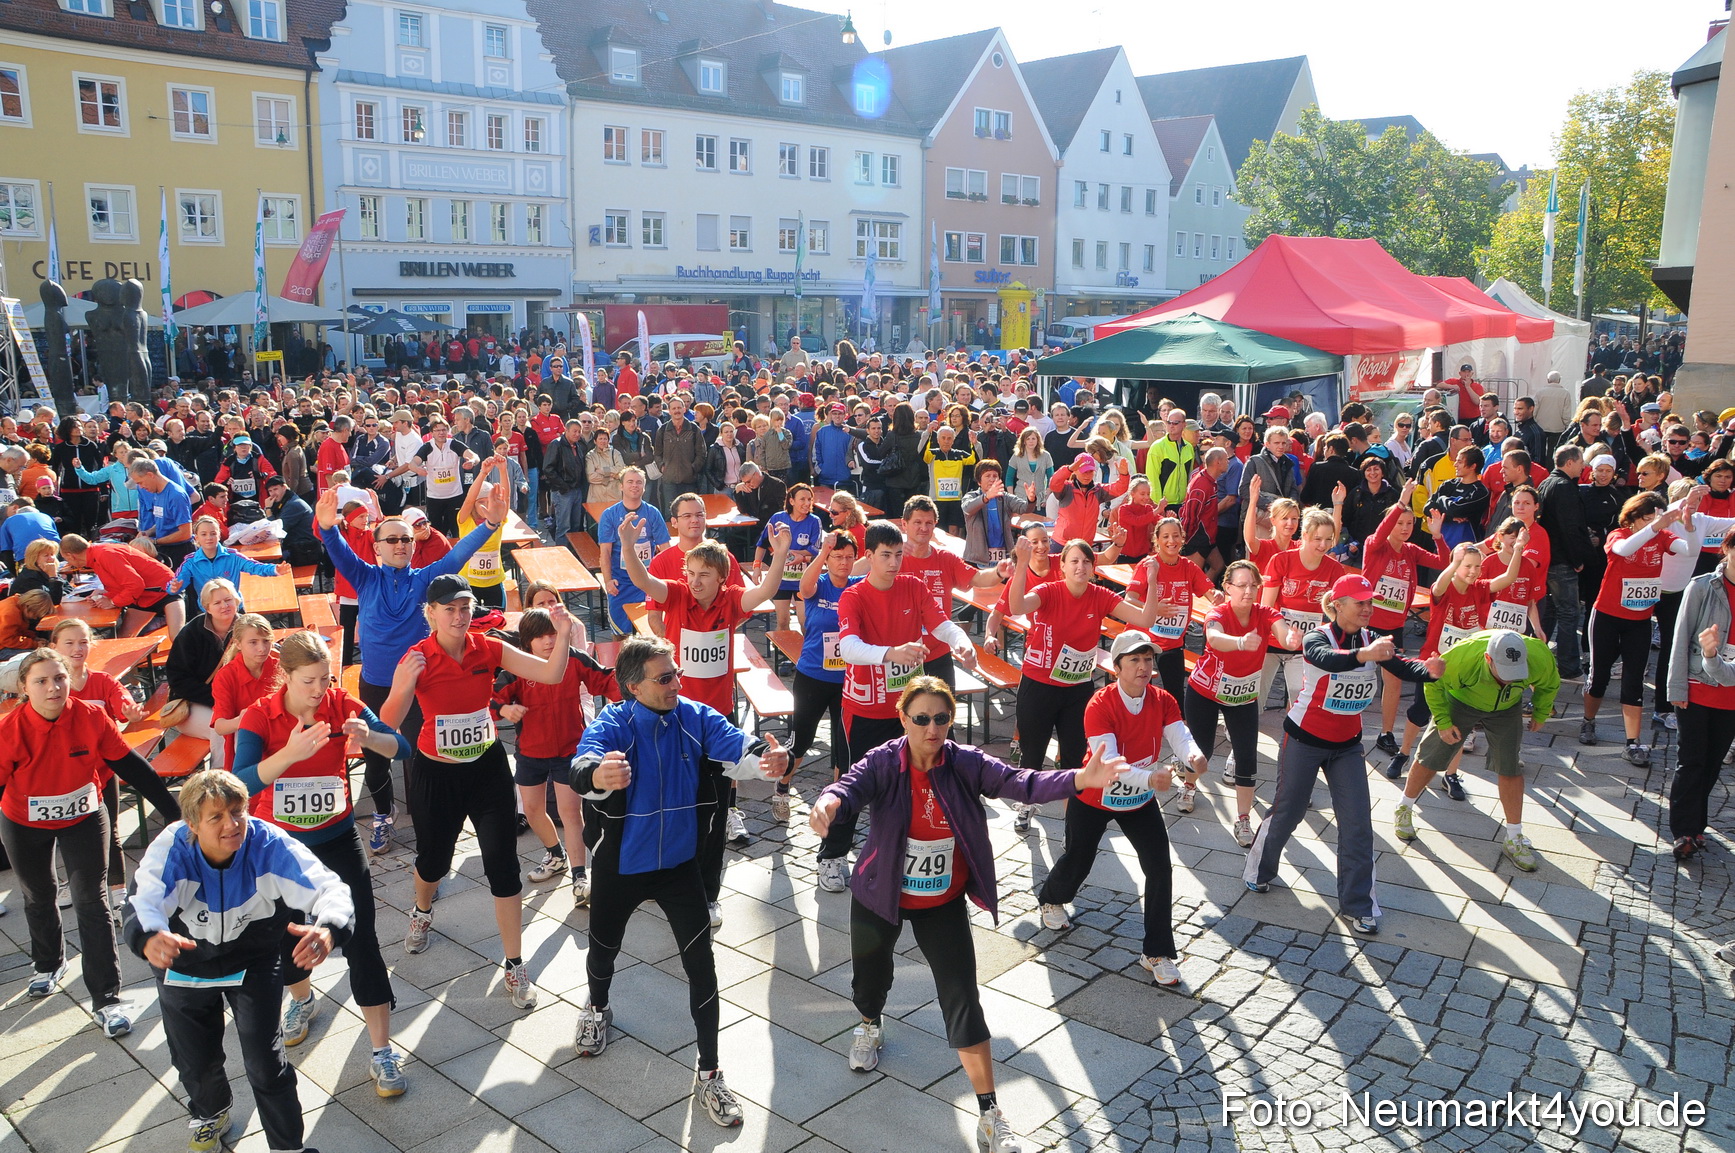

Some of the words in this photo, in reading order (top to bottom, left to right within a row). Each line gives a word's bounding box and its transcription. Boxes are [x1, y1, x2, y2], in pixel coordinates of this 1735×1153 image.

[409, 163, 460, 179] BRILLEN
[461, 166, 506, 182] WEBER
[590, 228, 600, 244] R
[32, 260, 94, 281] CFE
[105, 262, 152, 281] DELI
[399, 261, 459, 277] BRILLEN
[462, 262, 517, 278] WEBER
[677, 266, 762, 283] Buchhandlung
[765, 268, 820, 283] Ruppecht
[725, 337, 732, 349] A
[438, 471, 451, 480] 504
[234, 483, 253, 492] 2107
[940, 483, 958, 491] 3217
[473, 568, 496, 576] Susanne
[479, 559, 492, 570] 96
[1379, 584, 1406, 601] 5143
[1627, 586, 1658, 599] 2638
[1382, 599, 1398, 608] Anna
[1156, 615, 1185, 627] 2567
[1493, 609, 1523, 627] 4046
[1157, 625, 1181, 635] Tamara
[683, 646, 726, 664] 10095
[1044, 649, 1052, 668] MAX
[1505, 647, 1521, 662] SP
[1060, 657, 1094, 672] 5188
[877, 678, 886, 704] MAX
[1223, 681, 1256, 696] 5058
[1332, 682, 1373, 699] 2692
[1225, 694, 1251, 704] Tatjana
[439, 722, 491, 747] 10651
[284, 792, 335, 813] 5199
[1110, 793, 1149, 806] Veronika
[37, 796, 90, 820] 3348
[902, 878, 943, 889] anuela
